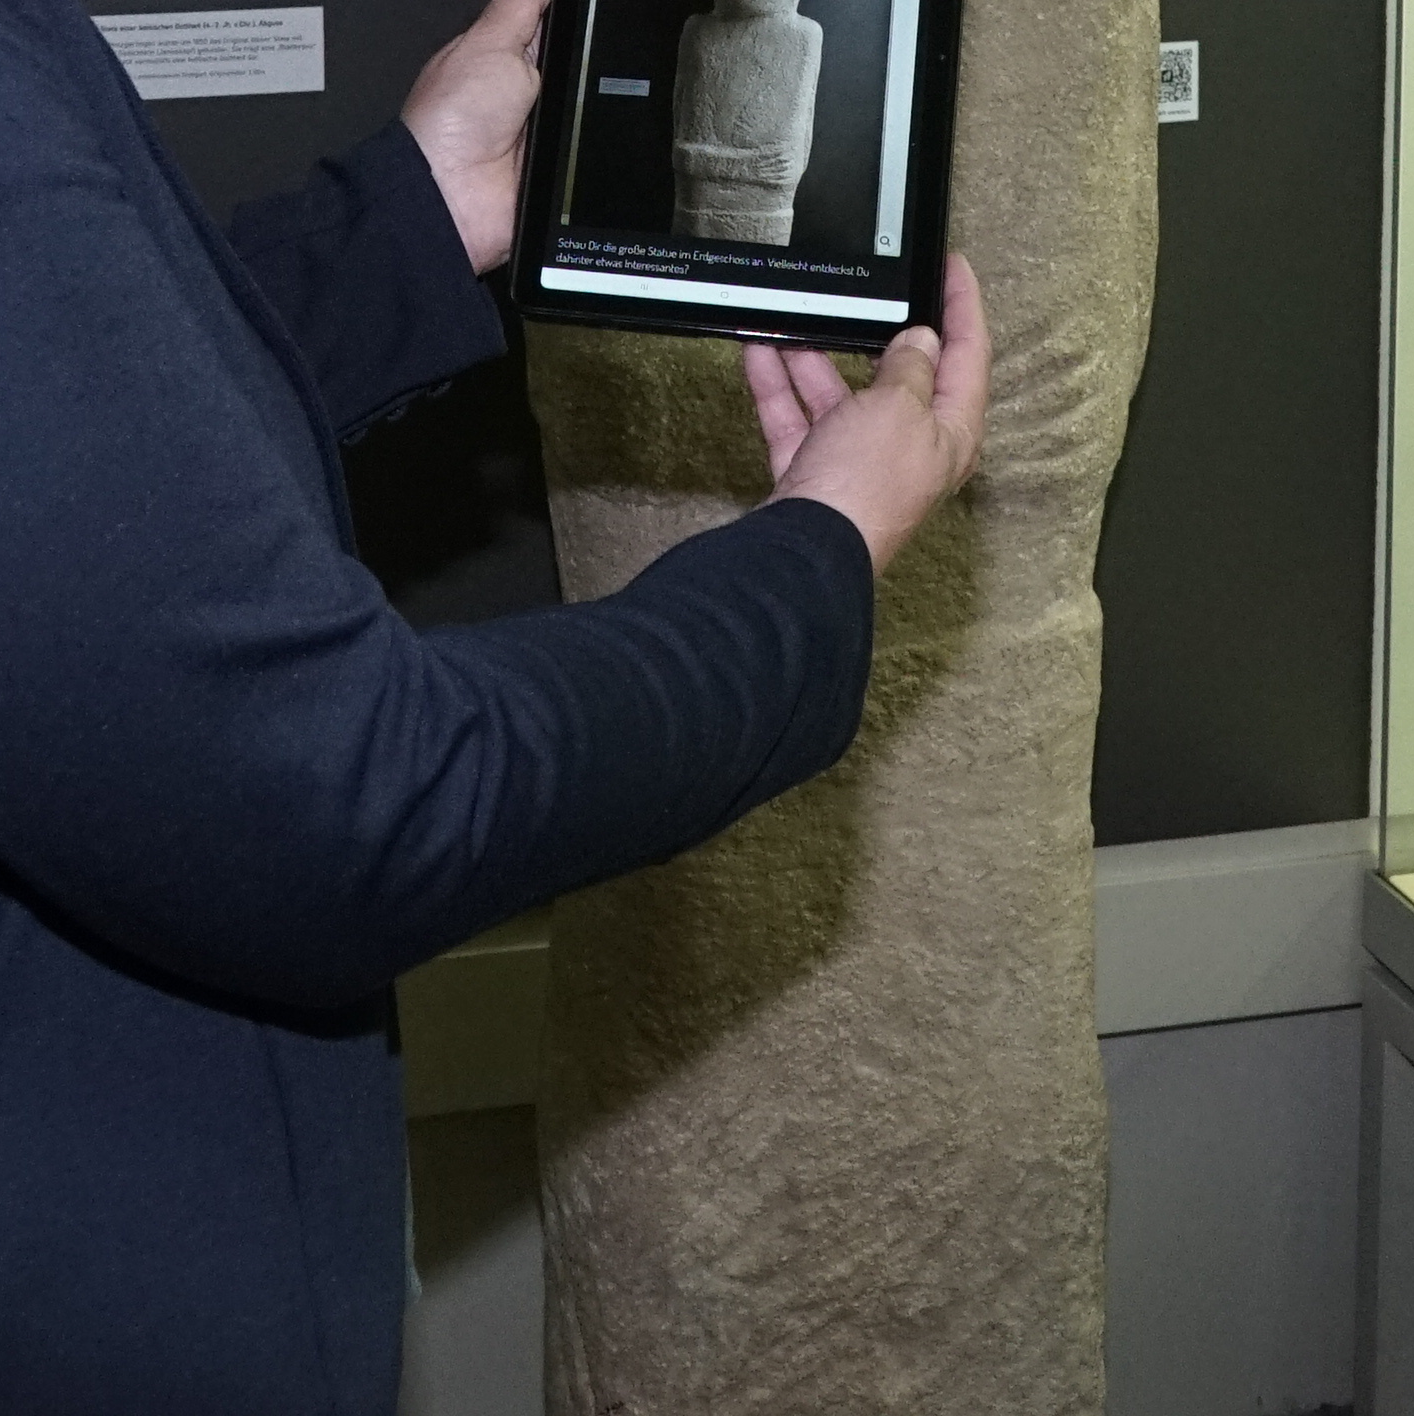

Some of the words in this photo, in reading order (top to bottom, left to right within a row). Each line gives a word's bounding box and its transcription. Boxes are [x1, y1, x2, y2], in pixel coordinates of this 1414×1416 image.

[555, 252, 594, 266] dahinter
[595, 257, 623, 269] etwas
[557, 237, 587, 251] Schau
[588, 240, 601, 252] Dir
[603, 242, 616, 253] die
[618, 244, 647, 257] große
[647, 246, 678, 259] Statue
[679, 249, 691, 260] im
[692, 250, 750, 266] Erdgeschoss
[767, 258, 809, 272] Vielleicht
[810, 263, 855, 277] entdeckst
[856, 266, 870, 278] Du
